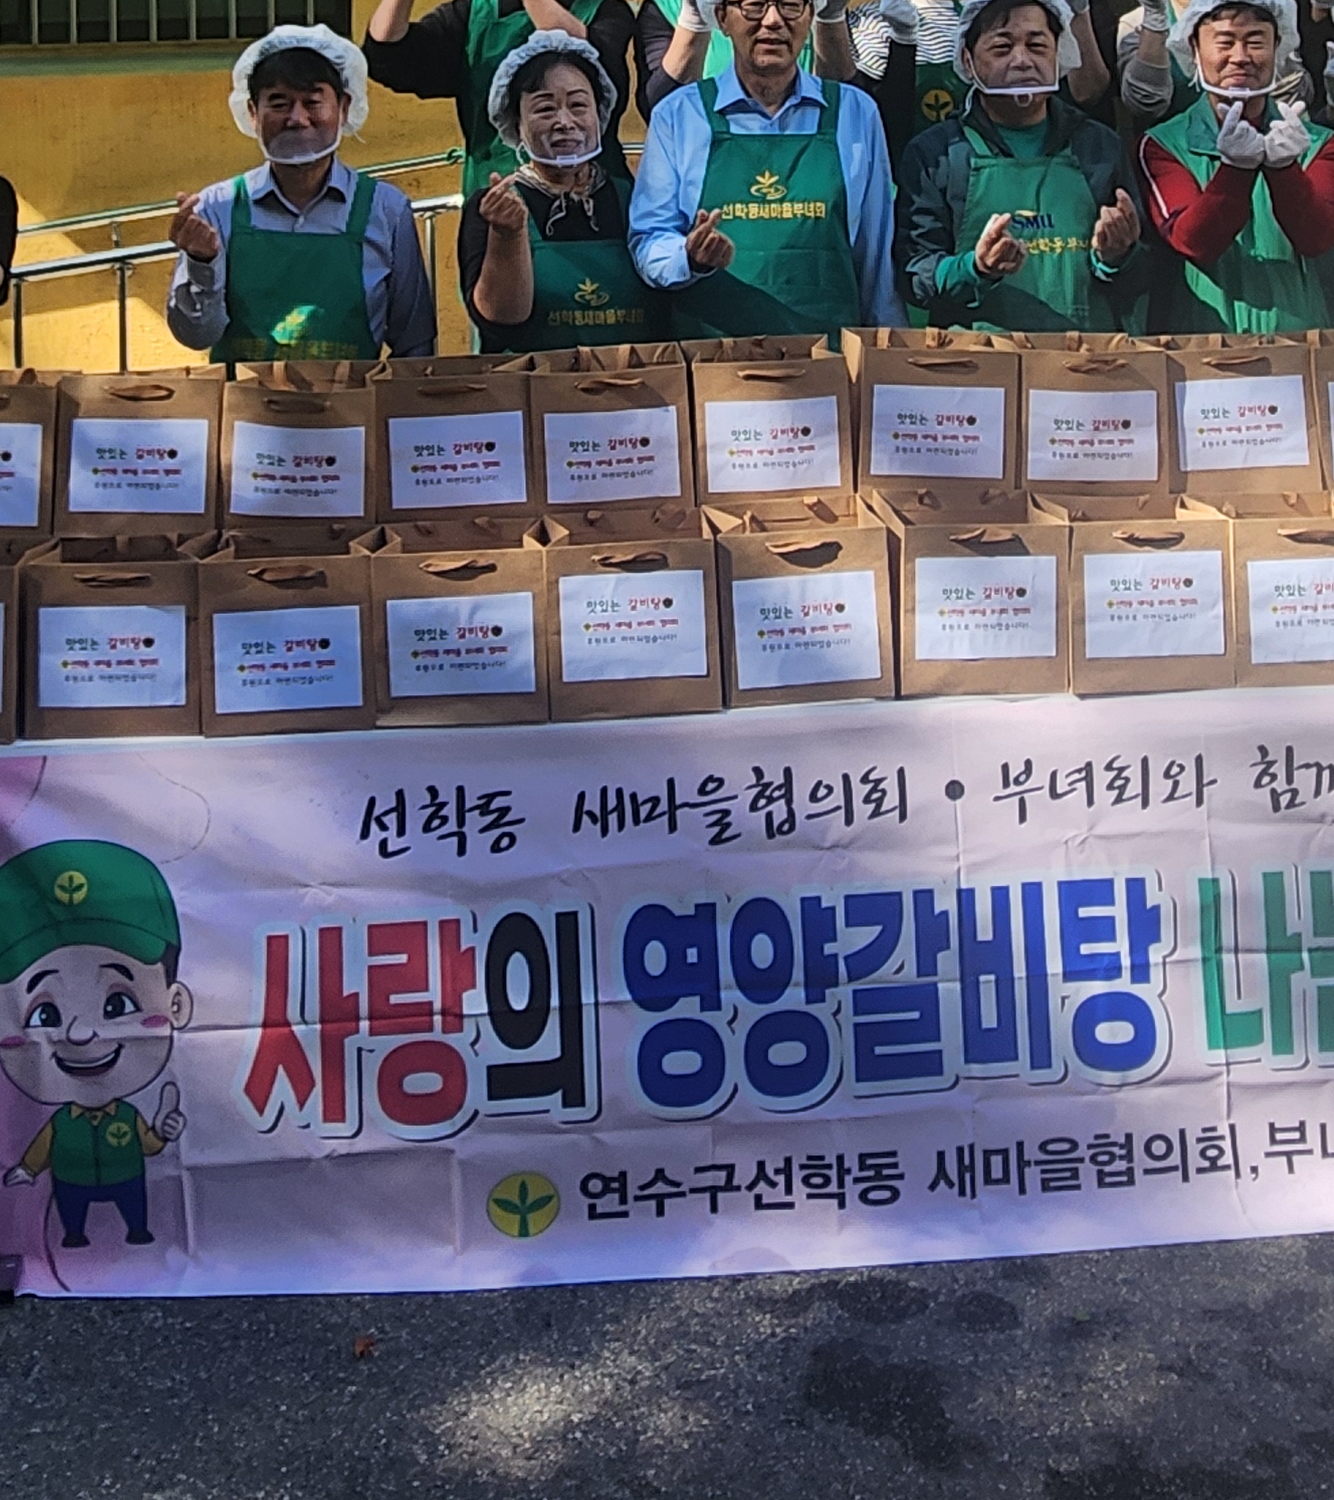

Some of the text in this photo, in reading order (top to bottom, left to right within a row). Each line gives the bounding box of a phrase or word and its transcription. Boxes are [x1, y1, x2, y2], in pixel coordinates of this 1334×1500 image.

[722, 202, 825, 219] 선학동새마을부녀회
[1238, 406, 1267, 417] 갈비탕
[935, 414, 966, 426] 갈비탕
[1092, 420, 1121, 431] 갈비탕
[770, 427, 801, 439] 갈비탕
[453, 442, 484, 455] 갈비탕
[608, 438, 638, 450] 갈비탕
[136, 448, 167, 459] 갈비탕
[293, 456, 325, 468] 갈비탕
[1150, 578, 1181, 590] 갈비탕
[983, 587, 1014, 599] 갈비탕
[628, 597, 660, 610] 갈비탕
[801, 604, 833, 617] 갈비탕
[456, 626, 489, 638] 갈비탕
[107, 638, 141, 650] 갈비탕
[284, 639, 317, 652] 갈비탕
[358, 784, 527, 856] 선학동
[571, 764, 909, 848] 새마을협의회
[992, 750, 1218, 824] 부녀회와
[243, 909, 589, 1128] 사랑의
[623, 876, 1162, 1111] 영양갈비탕
[578, 1154, 907, 1223] 연수구선학동
